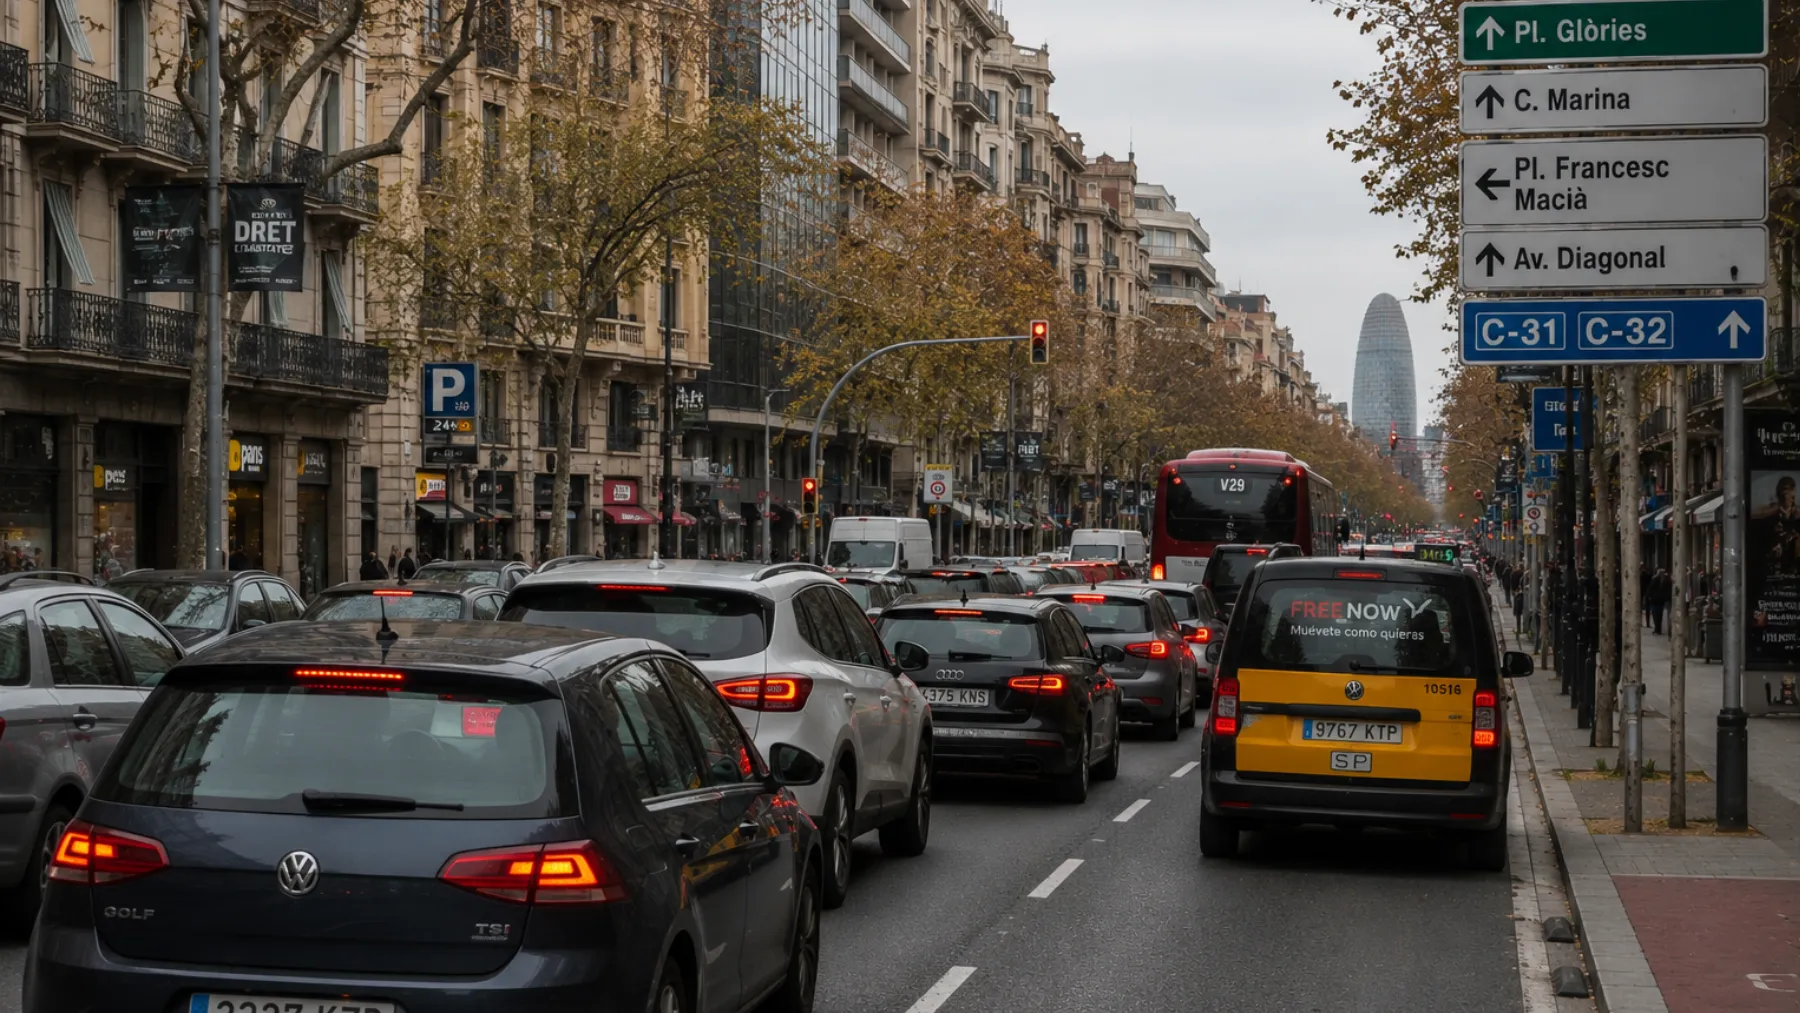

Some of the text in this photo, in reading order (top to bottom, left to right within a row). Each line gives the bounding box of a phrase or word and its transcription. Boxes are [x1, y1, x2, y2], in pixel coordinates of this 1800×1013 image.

[1515, 17, 1647, 43] Pl. Glòries
[1514, 87, 1631, 112] C. Marina
[1515, 155, 1669, 180] Pl. Francesc
[1515, 186, 1588, 211] Macià
[234, 220, 297, 243] DRET
[1514, 245, 1666, 274] Av. Diagonal
[1482, 316, 1667, 346] C-31 C-32
[432, 368, 466, 412] P
[1220, 478, 1246, 492] V29
[1290, 625, 1425, 641] Muévete como quieras
[959, 690, 986, 703] KNS
[1315, 722, 1398, 741] 9767 KTP
[1335, 754, 1368, 769] SP
[104, 906, 156, 920] GOLF
[475, 923, 511, 935] TSI
